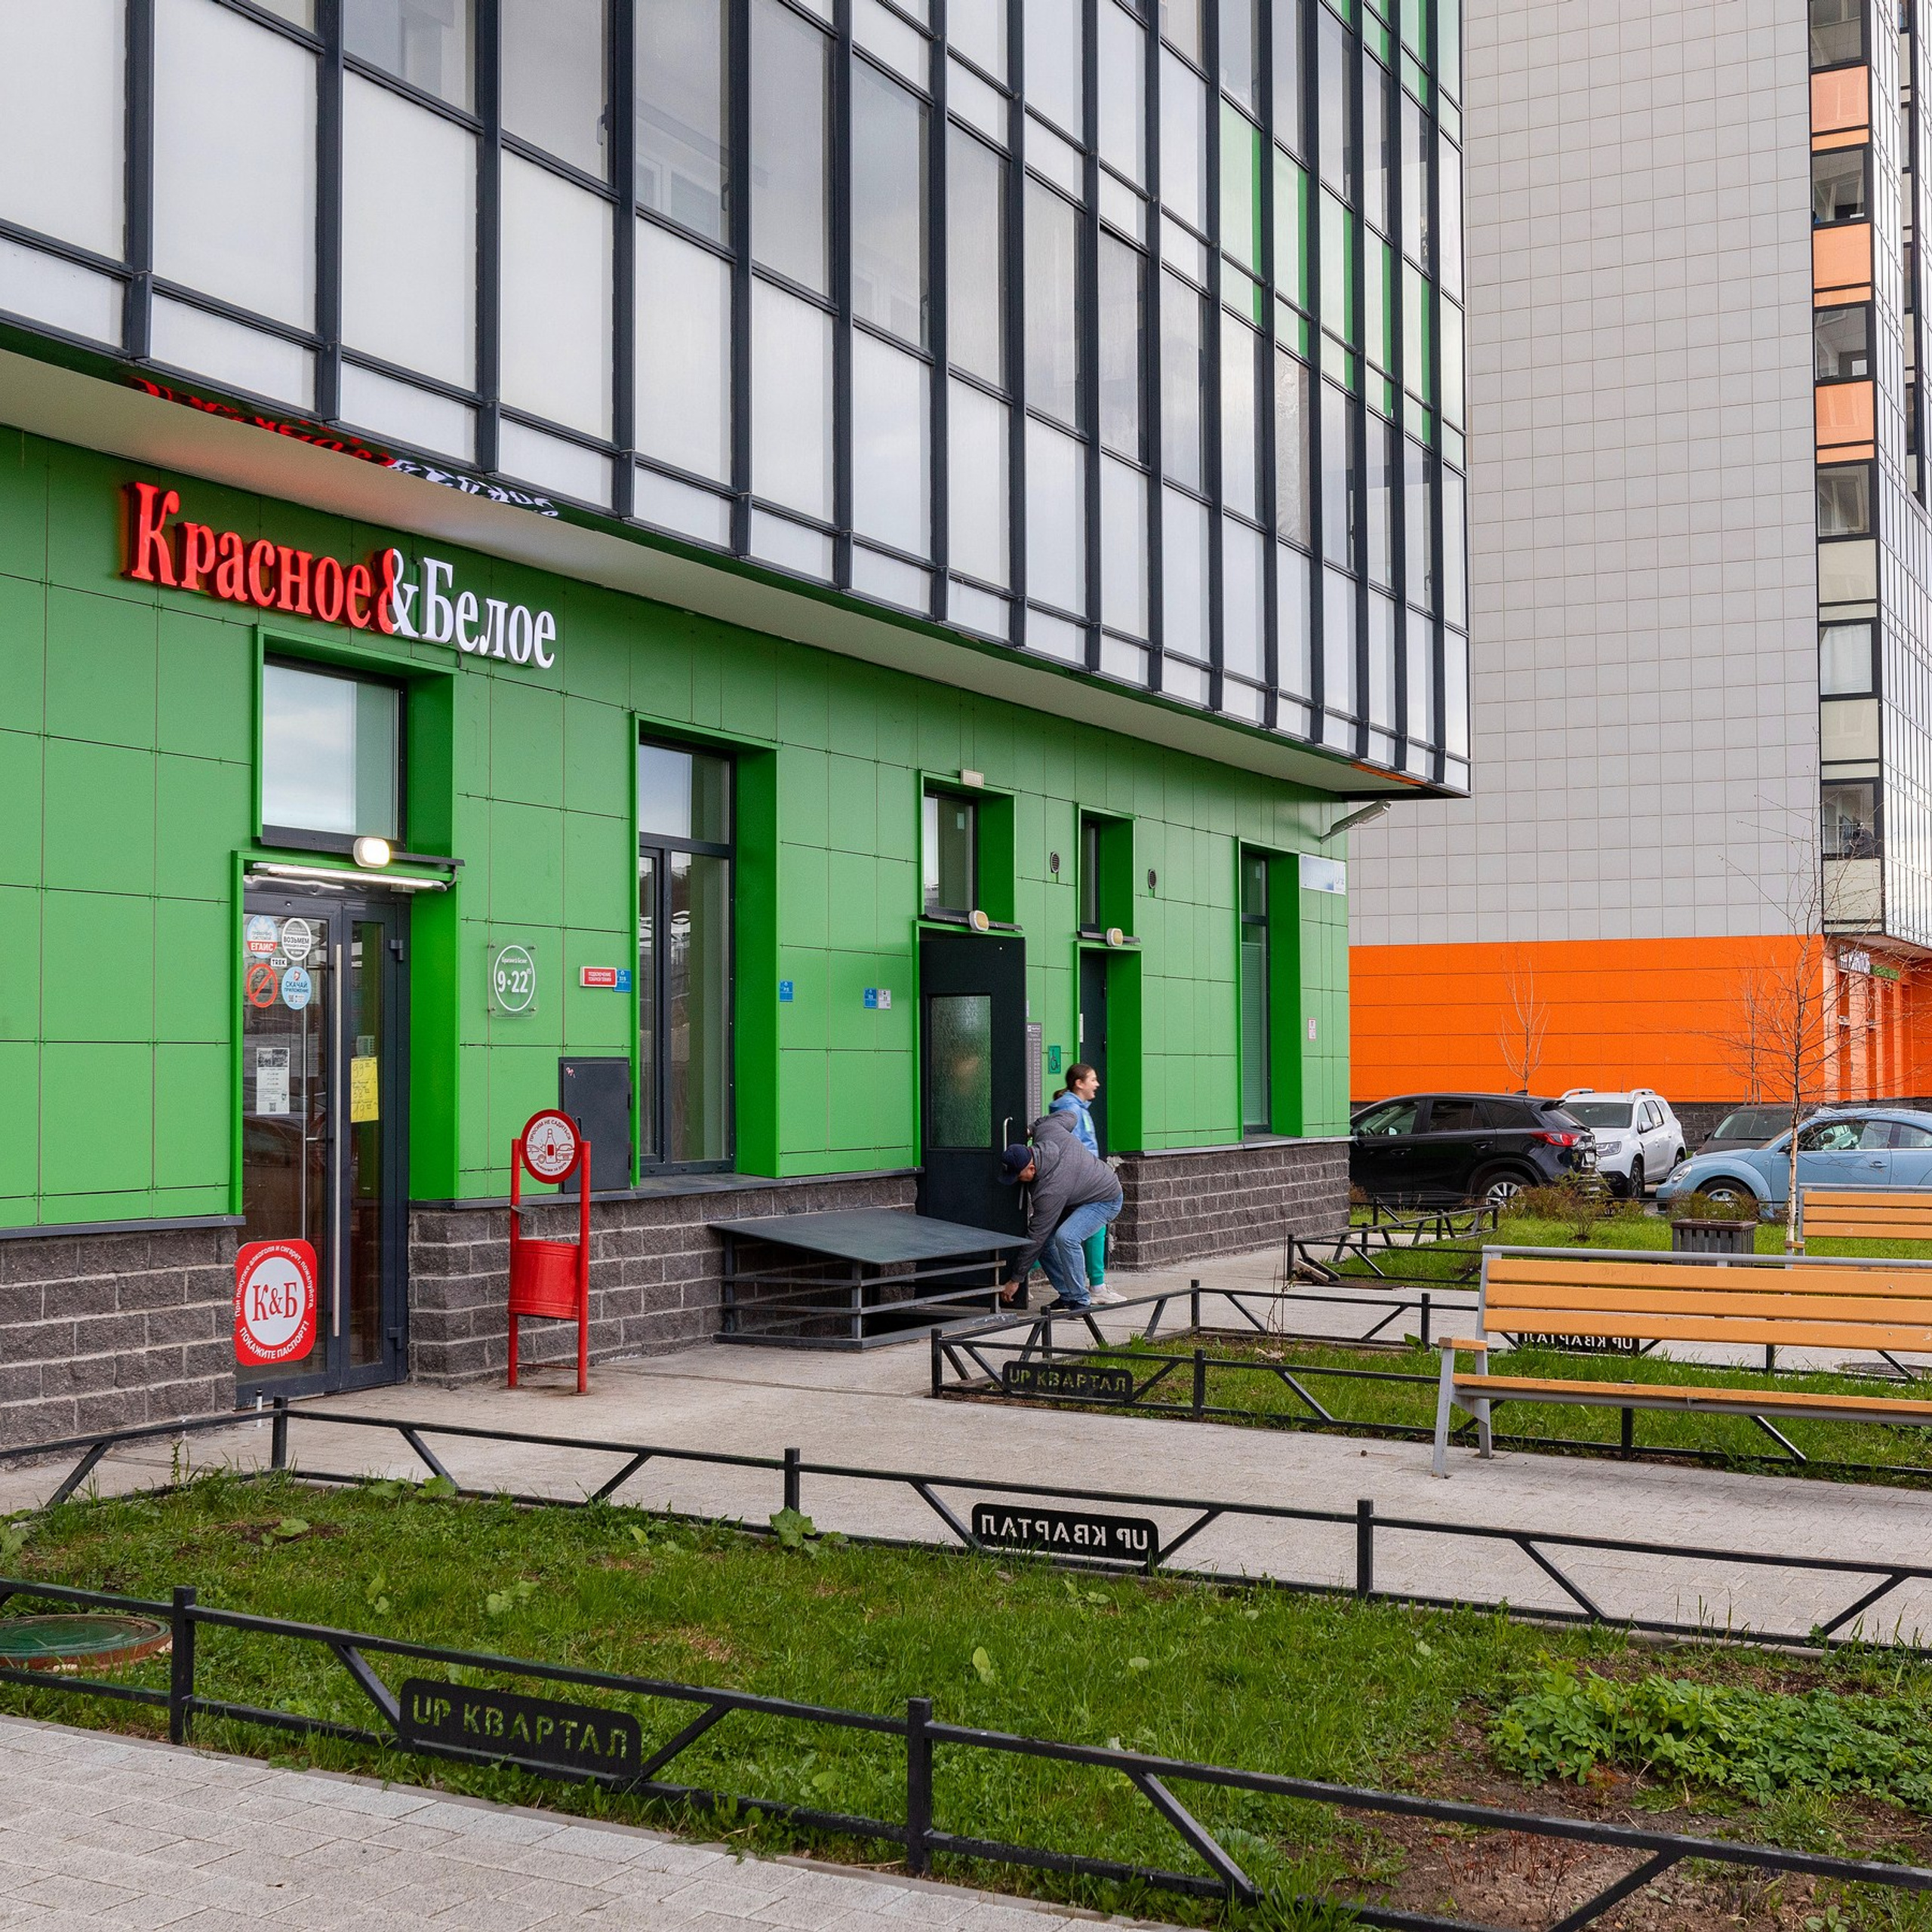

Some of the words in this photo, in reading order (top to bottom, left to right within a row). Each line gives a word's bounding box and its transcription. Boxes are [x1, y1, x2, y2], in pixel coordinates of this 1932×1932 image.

[127, 481, 557, 669] Красное&Белое
[251, 942, 274, 951] ЕГАИС
[550, 1119, 571, 1141] САДИТЬСЯ
[236, 1265, 251, 1298] покупке
[249, 1245, 275, 1266] алкоголя
[252, 1281, 298, 1321] К&Б
[239, 1326, 276, 1359] ПОКАЖИТЕ
[276, 1320, 310, 1358] ПАСПОРТ!
[1008, 1368, 1031, 1384] UP
[1036, 1370, 1127, 1392] КВАРТАЛ
[412, 1694, 451, 1727] UP
[463, 1703, 628, 1759] КВАРТАЛ
